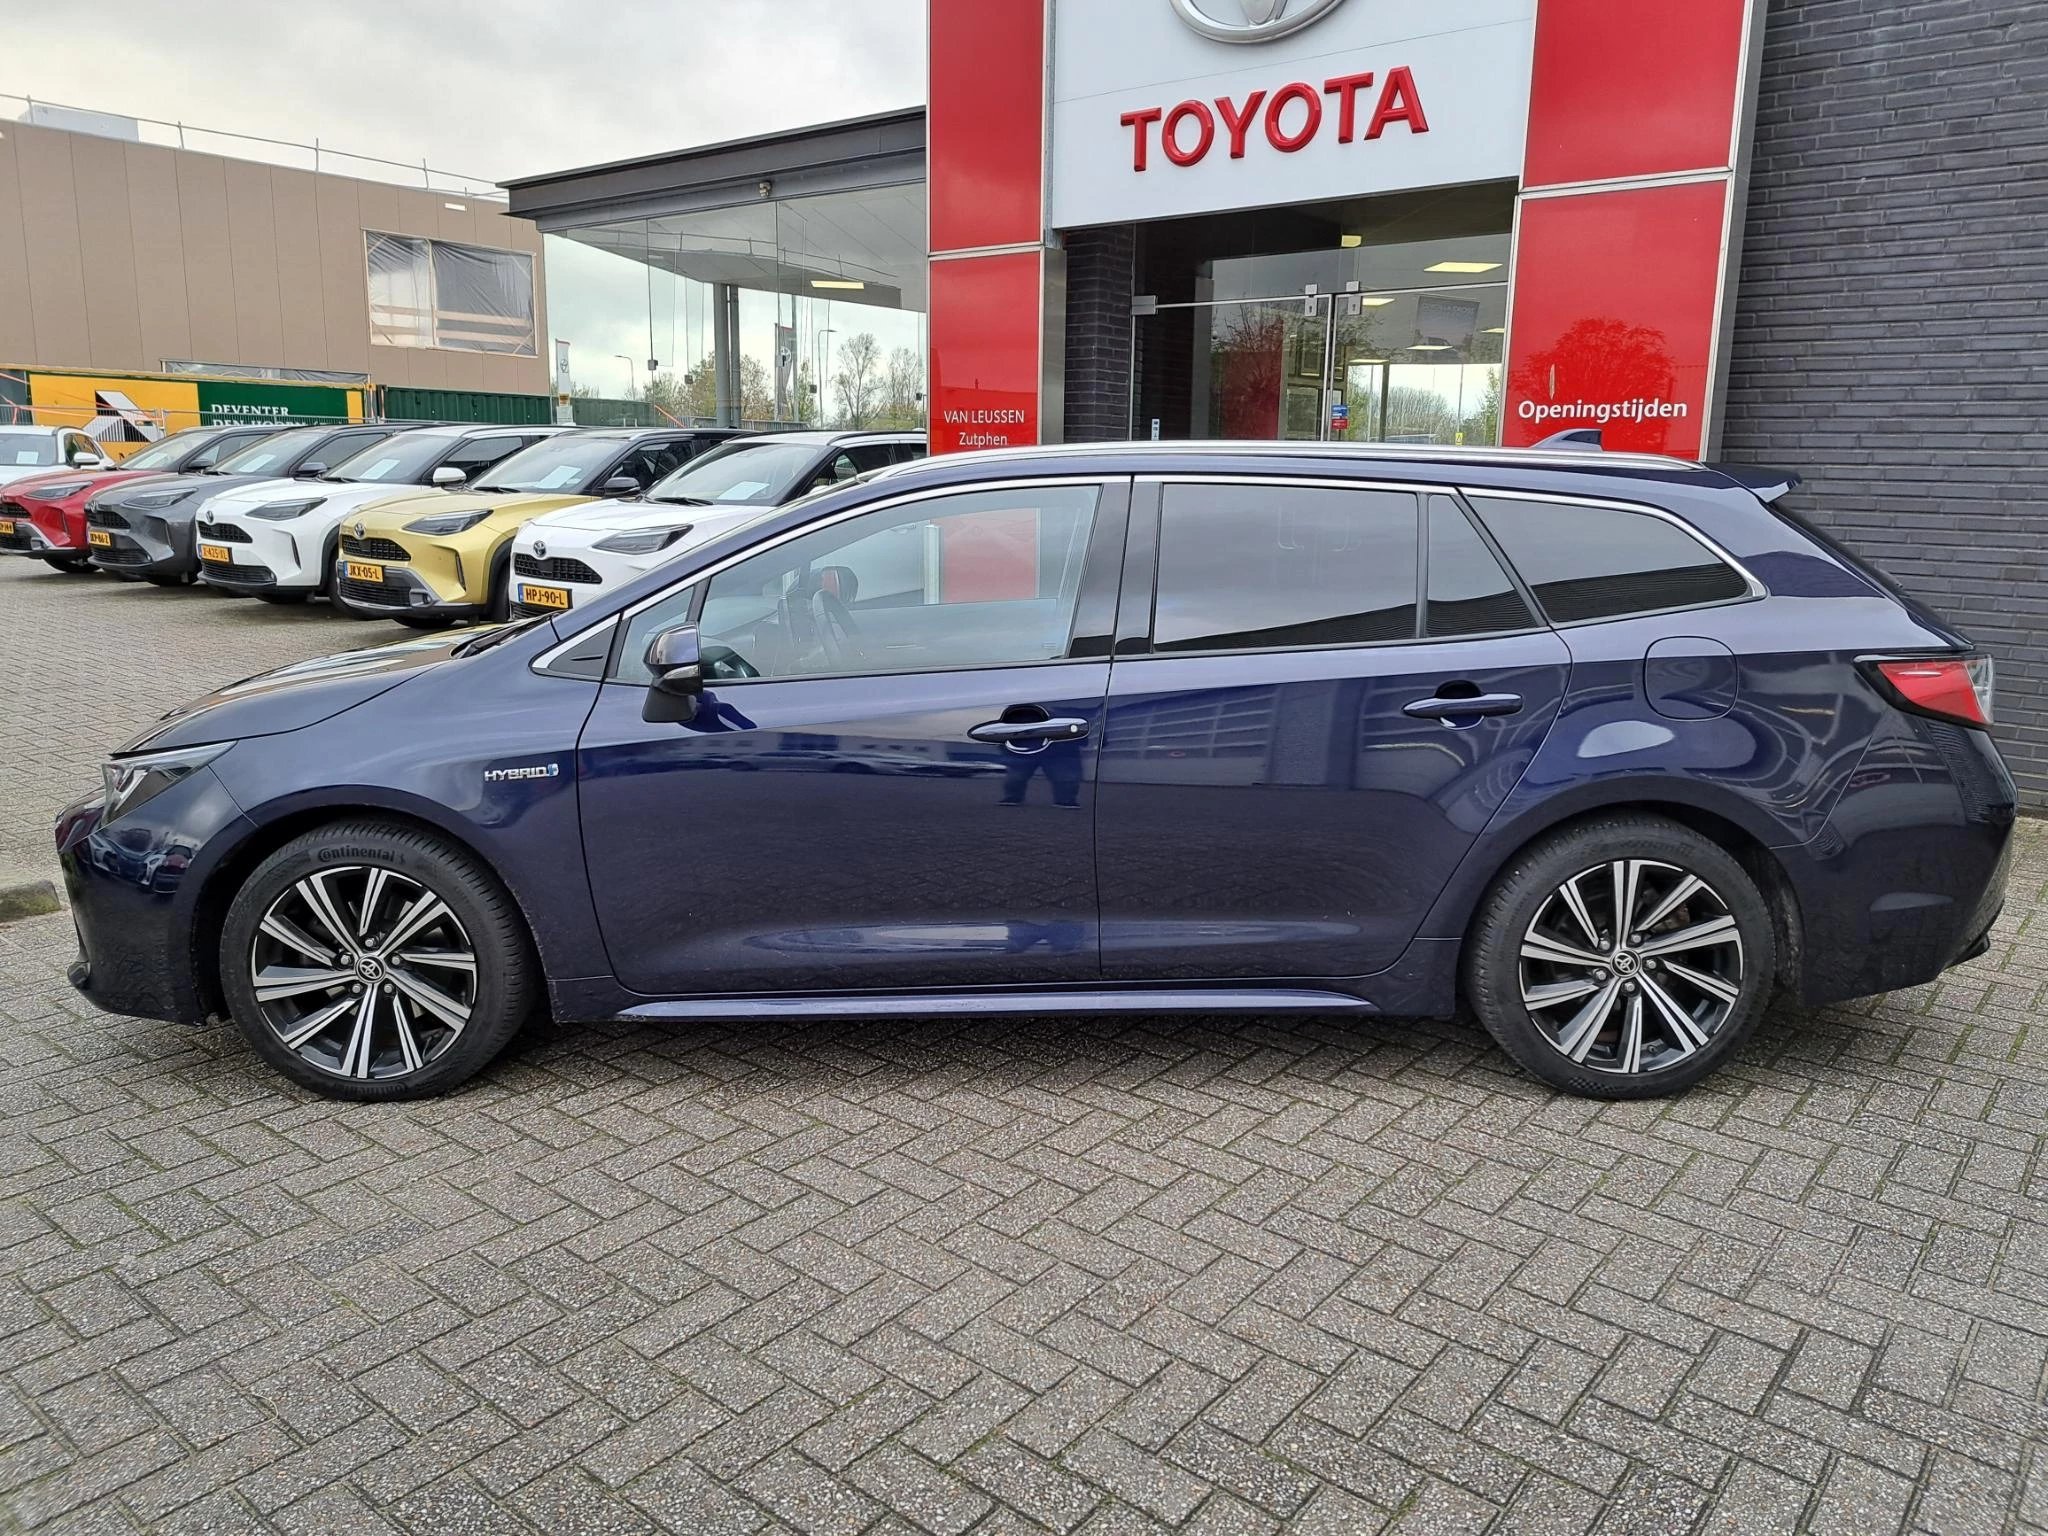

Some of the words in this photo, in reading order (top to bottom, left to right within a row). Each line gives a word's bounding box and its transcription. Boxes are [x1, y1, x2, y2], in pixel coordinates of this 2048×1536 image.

[1120, 66, 1429, 172] TOYOTA
[211, 404, 289, 416] DEVENTER
[943, 410, 968, 424] VAN
[971, 409, 1025, 424] LEUSSEN
[1518, 398, 1687, 423] Openingstijden
[959, 432, 1008, 448] Zutphen
[349, 564, 380, 580] JKX-05-L
[525, 587, 565, 606] HPJ-90-L
[484, 766, 547, 781] HYBRID
[318, 845, 396, 862] Continental
